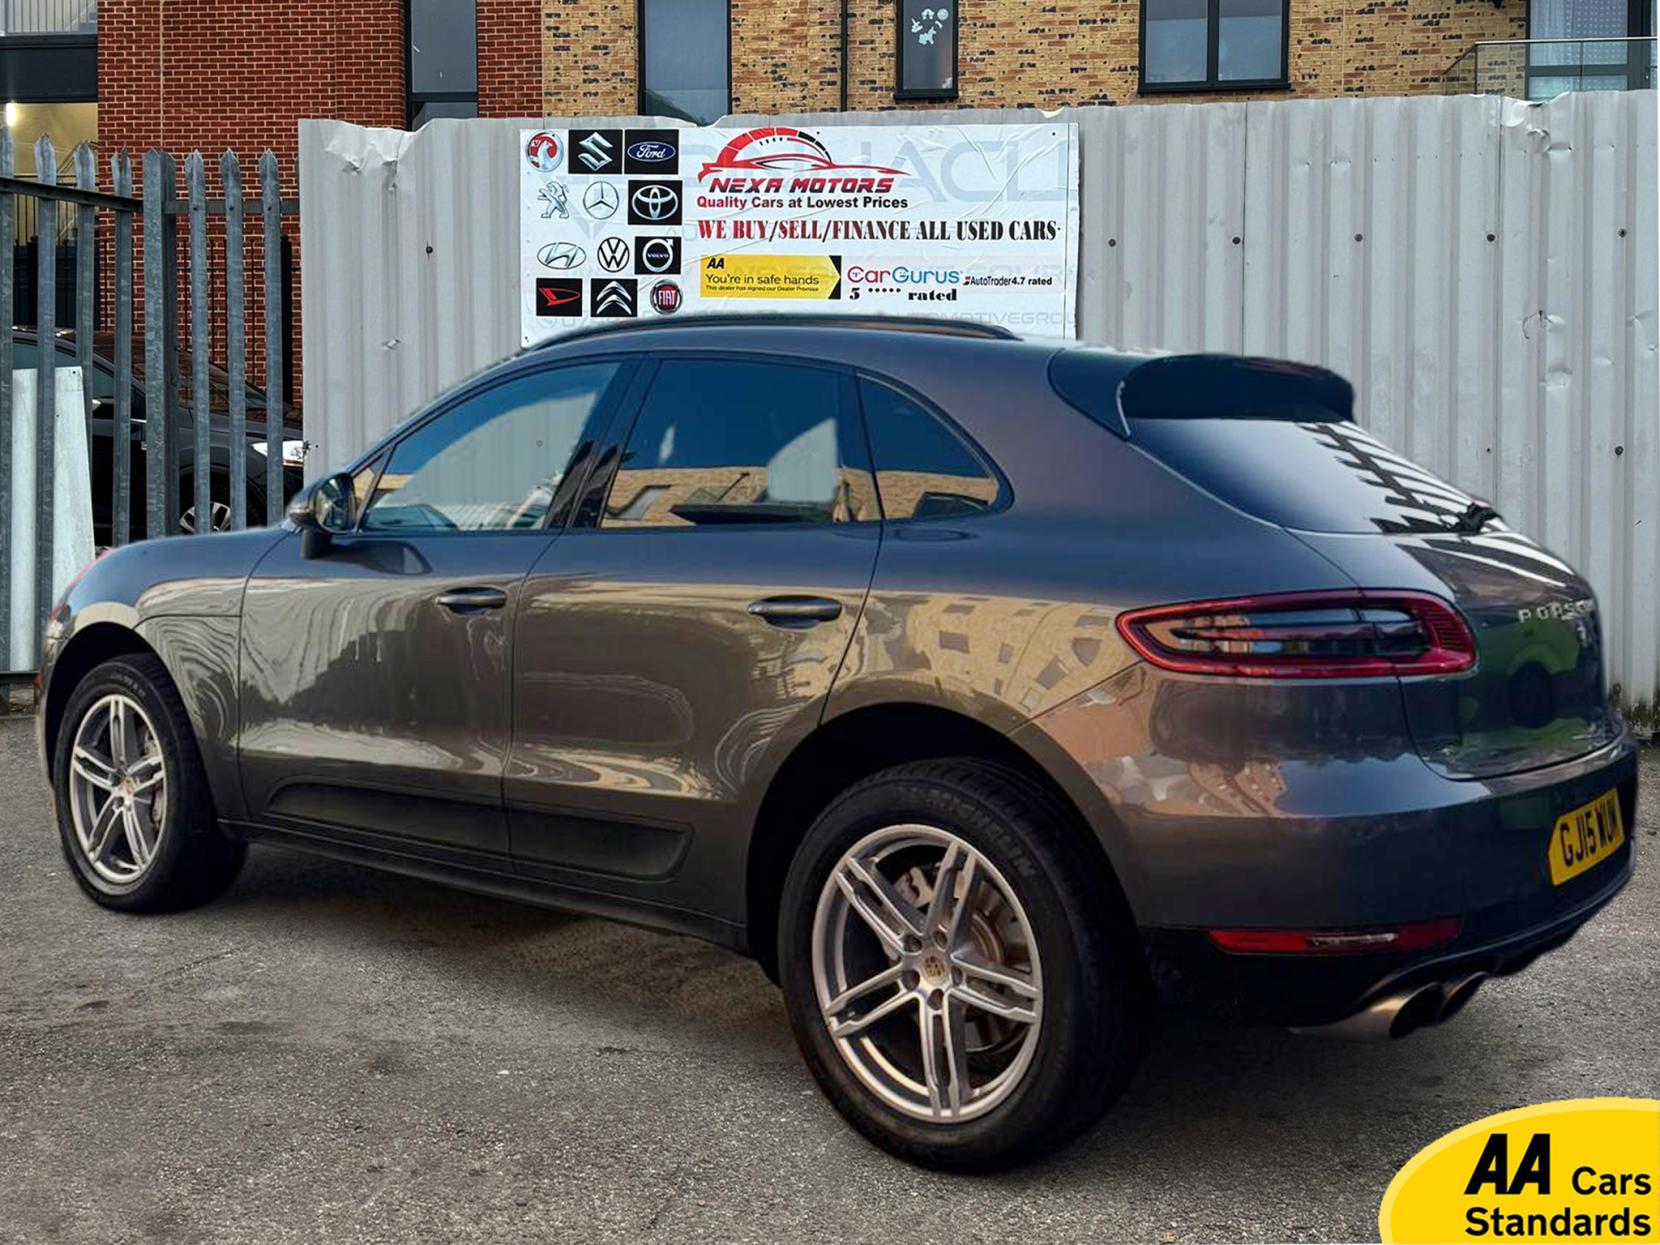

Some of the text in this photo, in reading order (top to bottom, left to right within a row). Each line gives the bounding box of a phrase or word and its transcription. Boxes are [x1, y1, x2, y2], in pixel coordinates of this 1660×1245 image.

[636, 142, 667, 159] Ford
[708, 177, 896, 194] NEXA MOTORS
[697, 195, 908, 211] Quality Cars at Lowest Prices
[697, 219, 727, 240] WE
[916, 220, 951, 240] ALL
[956, 220, 1004, 241] USED
[706, 257, 725, 269] AA
[706, 273, 820, 285] You're in safe hands
[847, 266, 960, 284] CarGurus
[1011, 276, 1026, 285] 4.7
[1028, 276, 1053, 286] rated
[657, 290, 677, 306] FIAT
[849, 287, 958, 301] 5 rated
